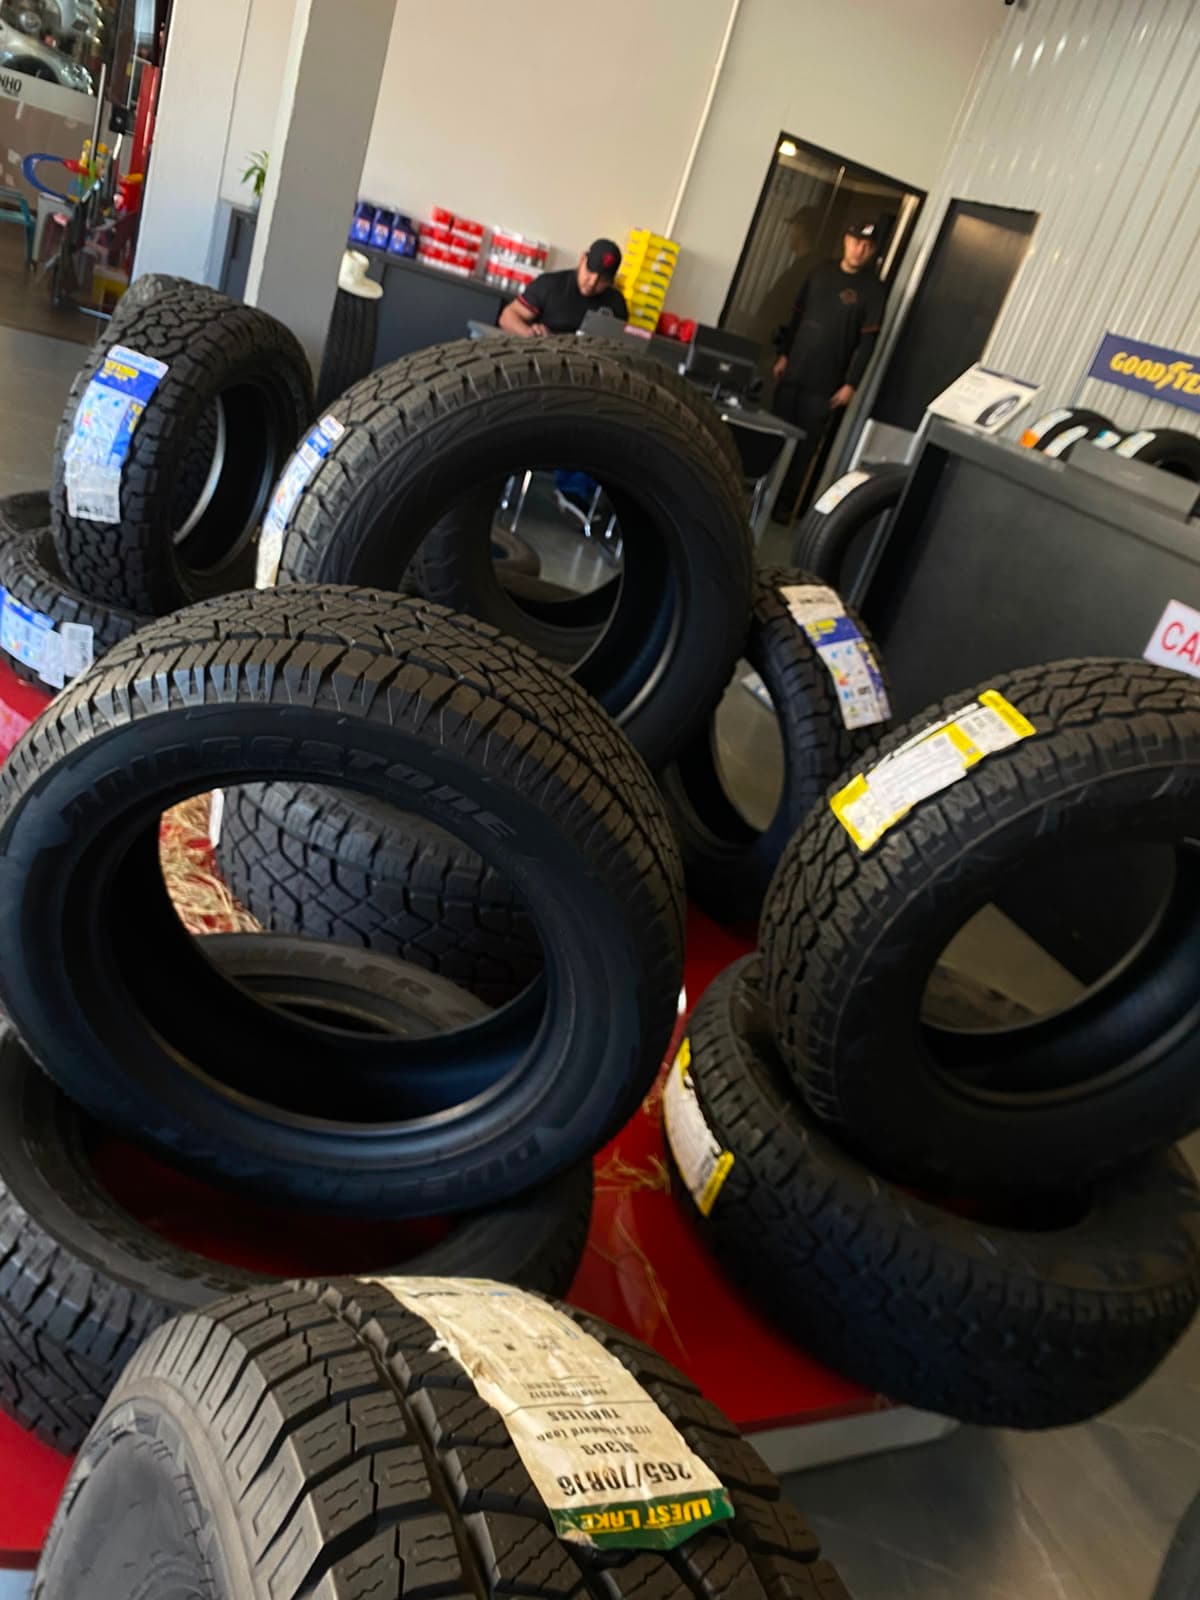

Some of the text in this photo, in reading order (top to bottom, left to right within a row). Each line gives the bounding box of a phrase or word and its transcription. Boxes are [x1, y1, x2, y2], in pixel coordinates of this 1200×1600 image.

[1161, 620, 1200, 666] CA
[556, 1461, 691, 1497] 265/70R16
[580, 1498, 712, 1530] WEST LAKE
